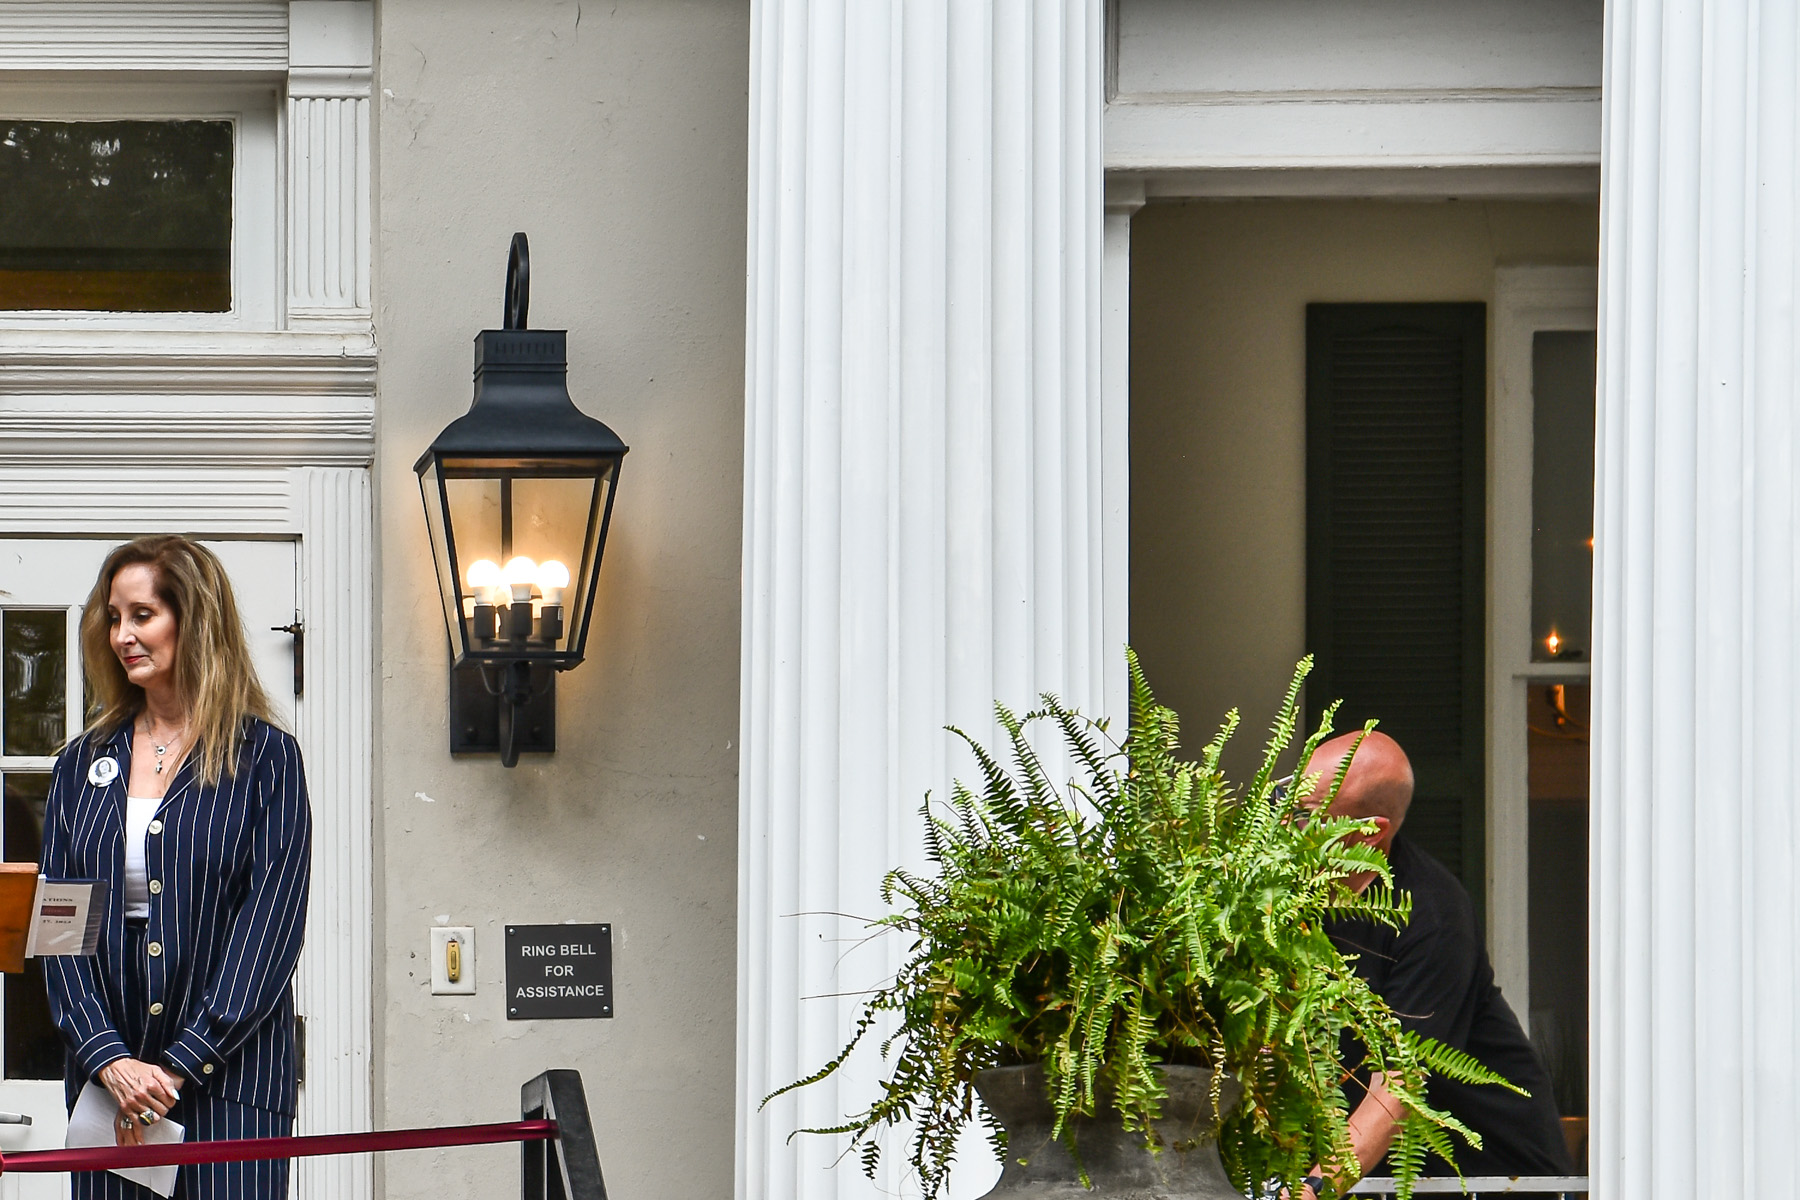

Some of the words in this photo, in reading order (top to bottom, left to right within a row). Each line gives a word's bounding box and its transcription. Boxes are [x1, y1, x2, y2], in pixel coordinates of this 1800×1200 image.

[521, 944, 556, 957] RING
[560, 944, 597, 956] BELL
[545, 965, 574, 977] FOR
[515, 984, 605, 998] ASSISTANCE
